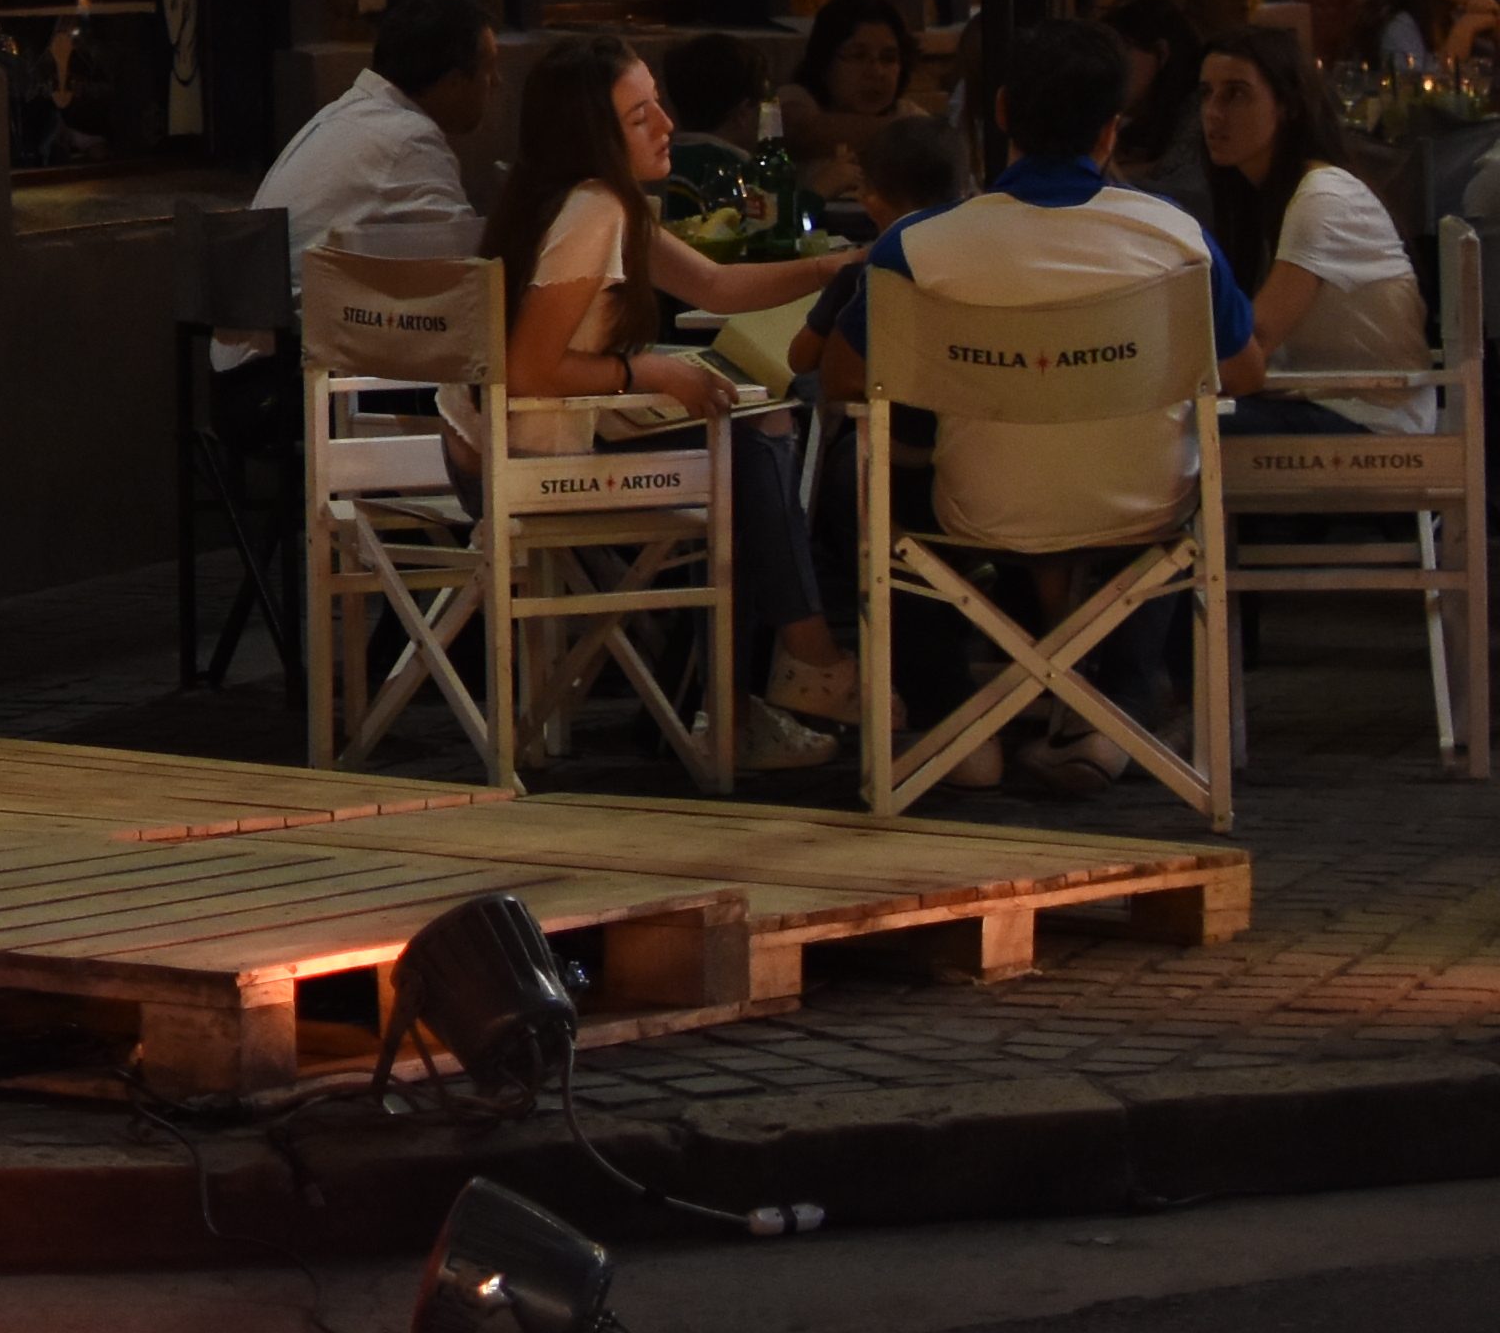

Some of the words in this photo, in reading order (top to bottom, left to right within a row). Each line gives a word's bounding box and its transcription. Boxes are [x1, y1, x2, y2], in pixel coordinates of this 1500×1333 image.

[342, 306, 383, 328] STELLA
[396, 313, 447, 332] ARTOIS
[948, 343, 1028, 369] STELLA
[1056, 341, 1138, 367] ARTOIS
[1252, 454, 1325, 470] STELLA
[1348, 453, 1424, 470] ARTOIS
[540, 477, 600, 494] STELLA
[620, 472, 681, 490] ARTOIS
